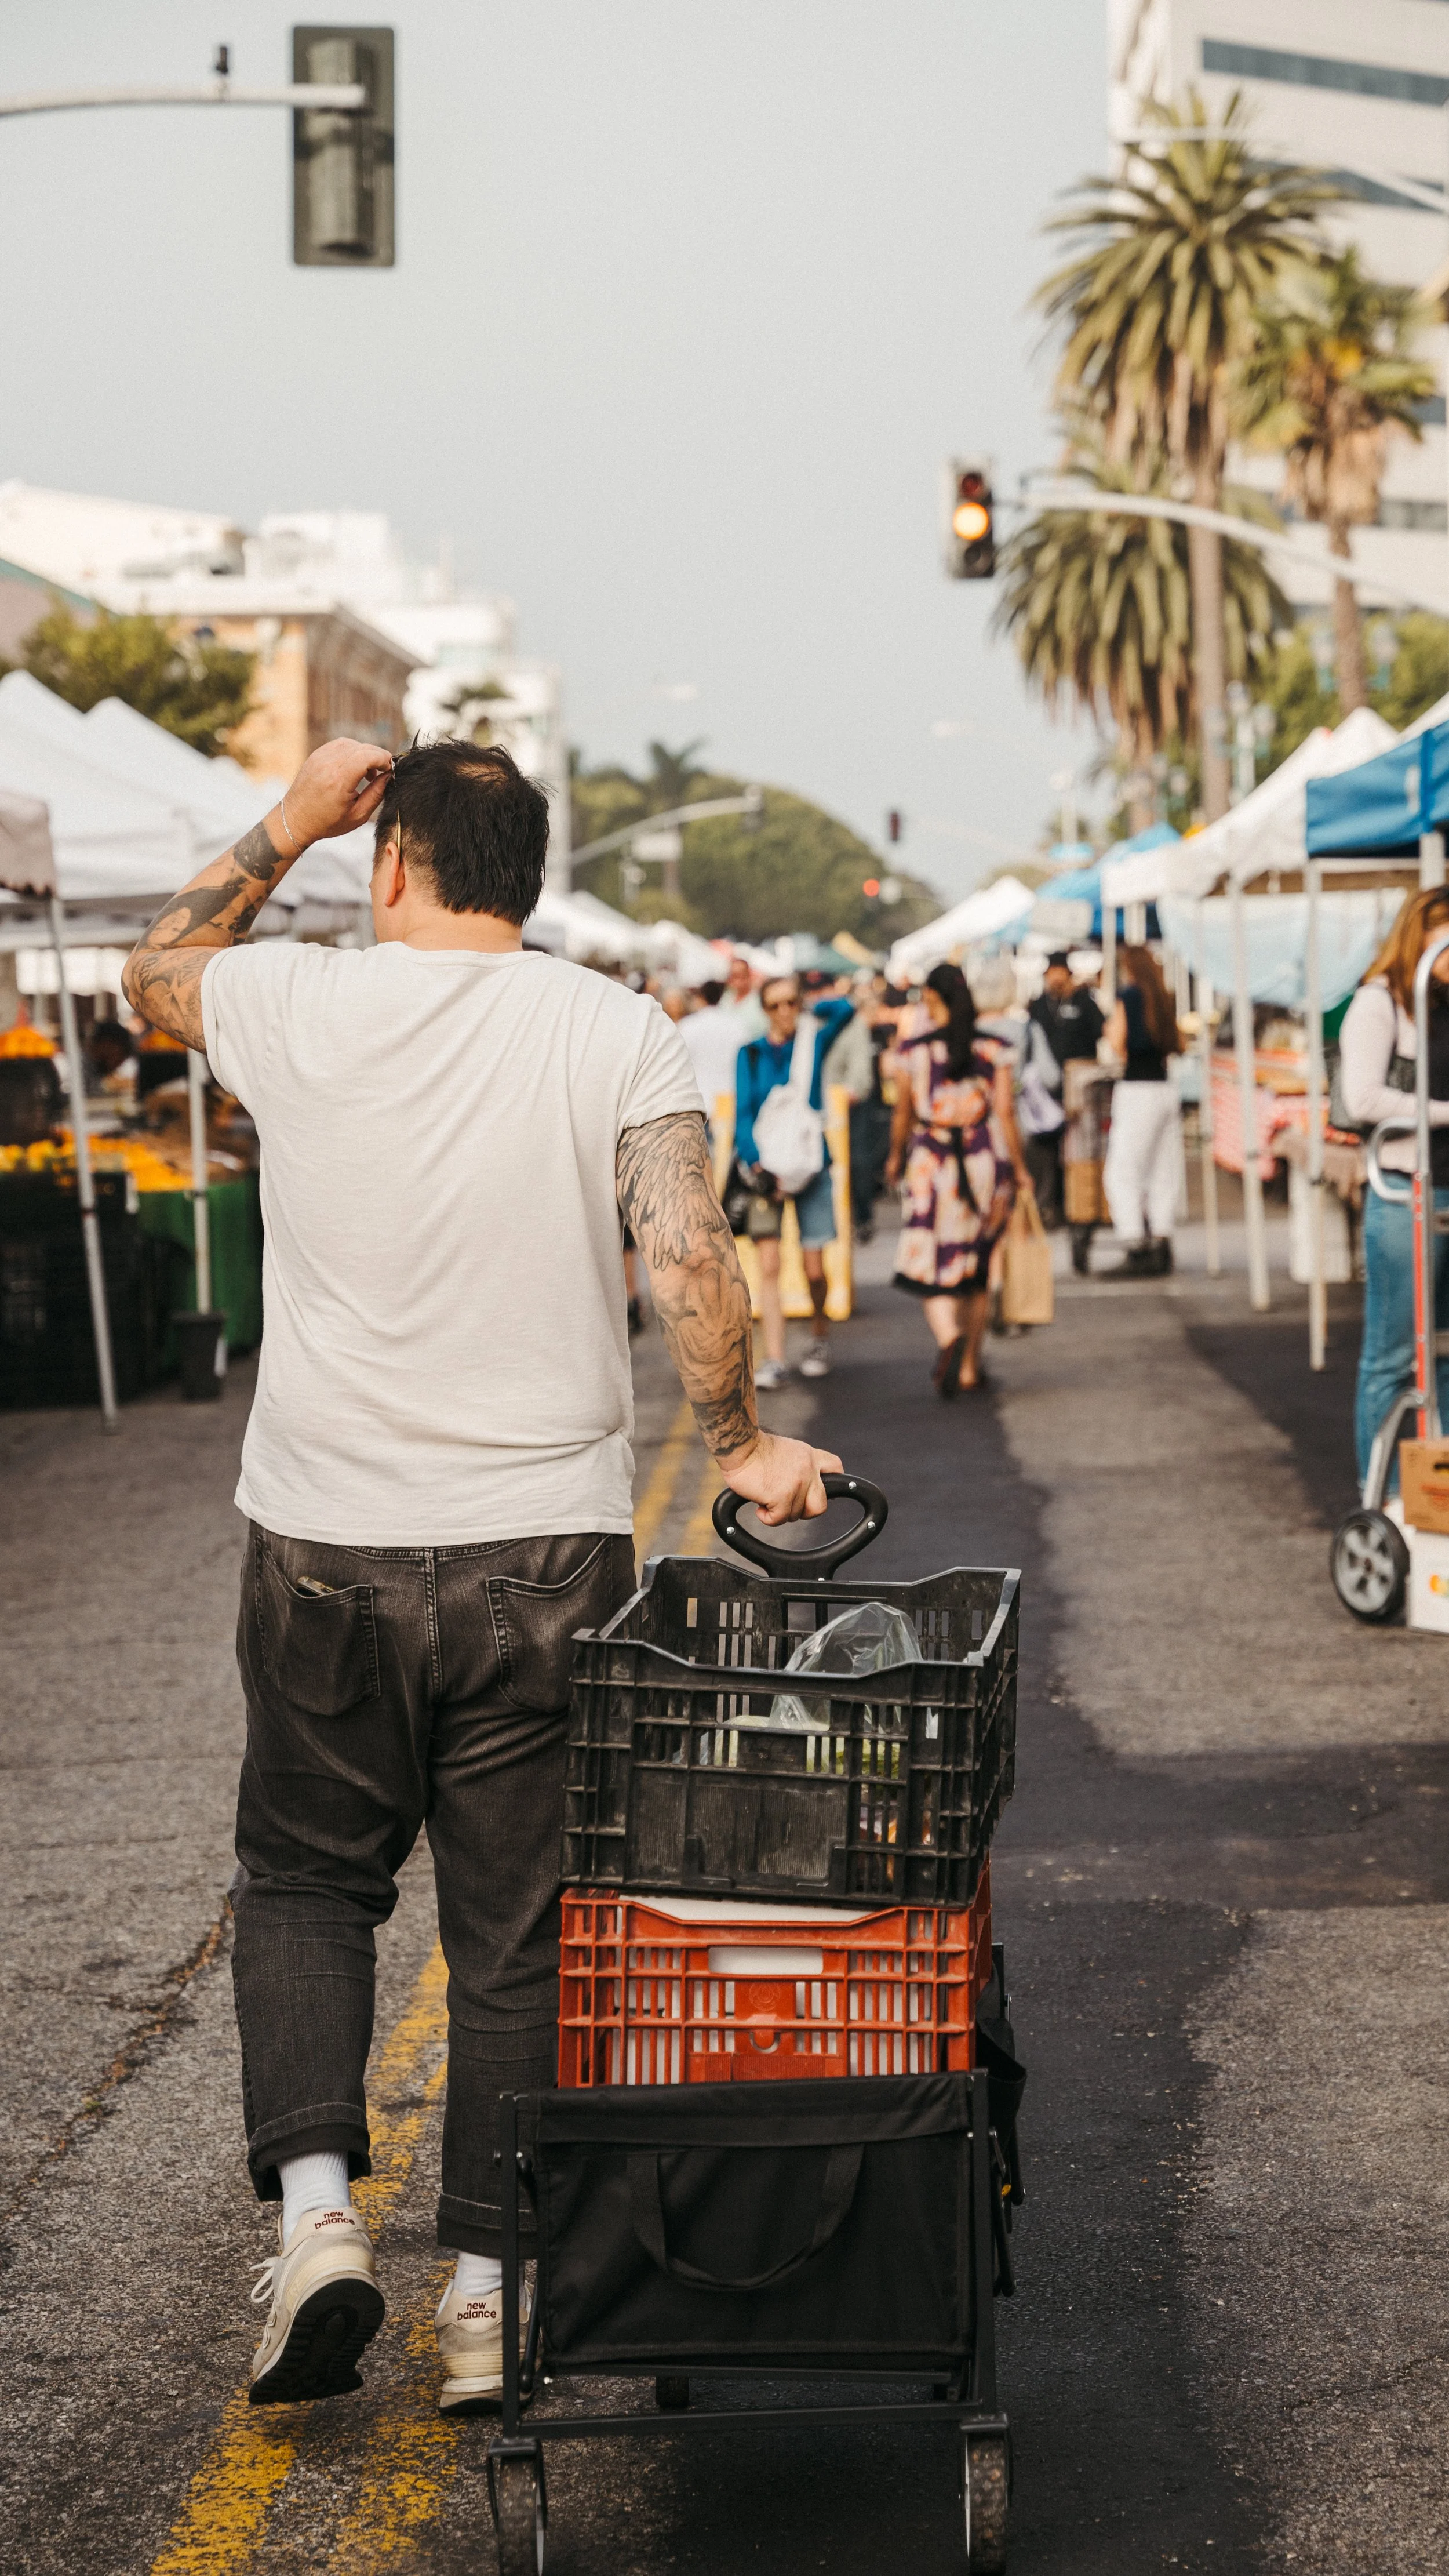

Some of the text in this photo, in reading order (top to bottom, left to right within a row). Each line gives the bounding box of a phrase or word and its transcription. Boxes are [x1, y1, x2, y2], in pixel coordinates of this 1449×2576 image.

[314, 2218, 355, 2230] balance
[467, 2302, 486, 2310] new
[457, 2310, 497, 2321] balance
